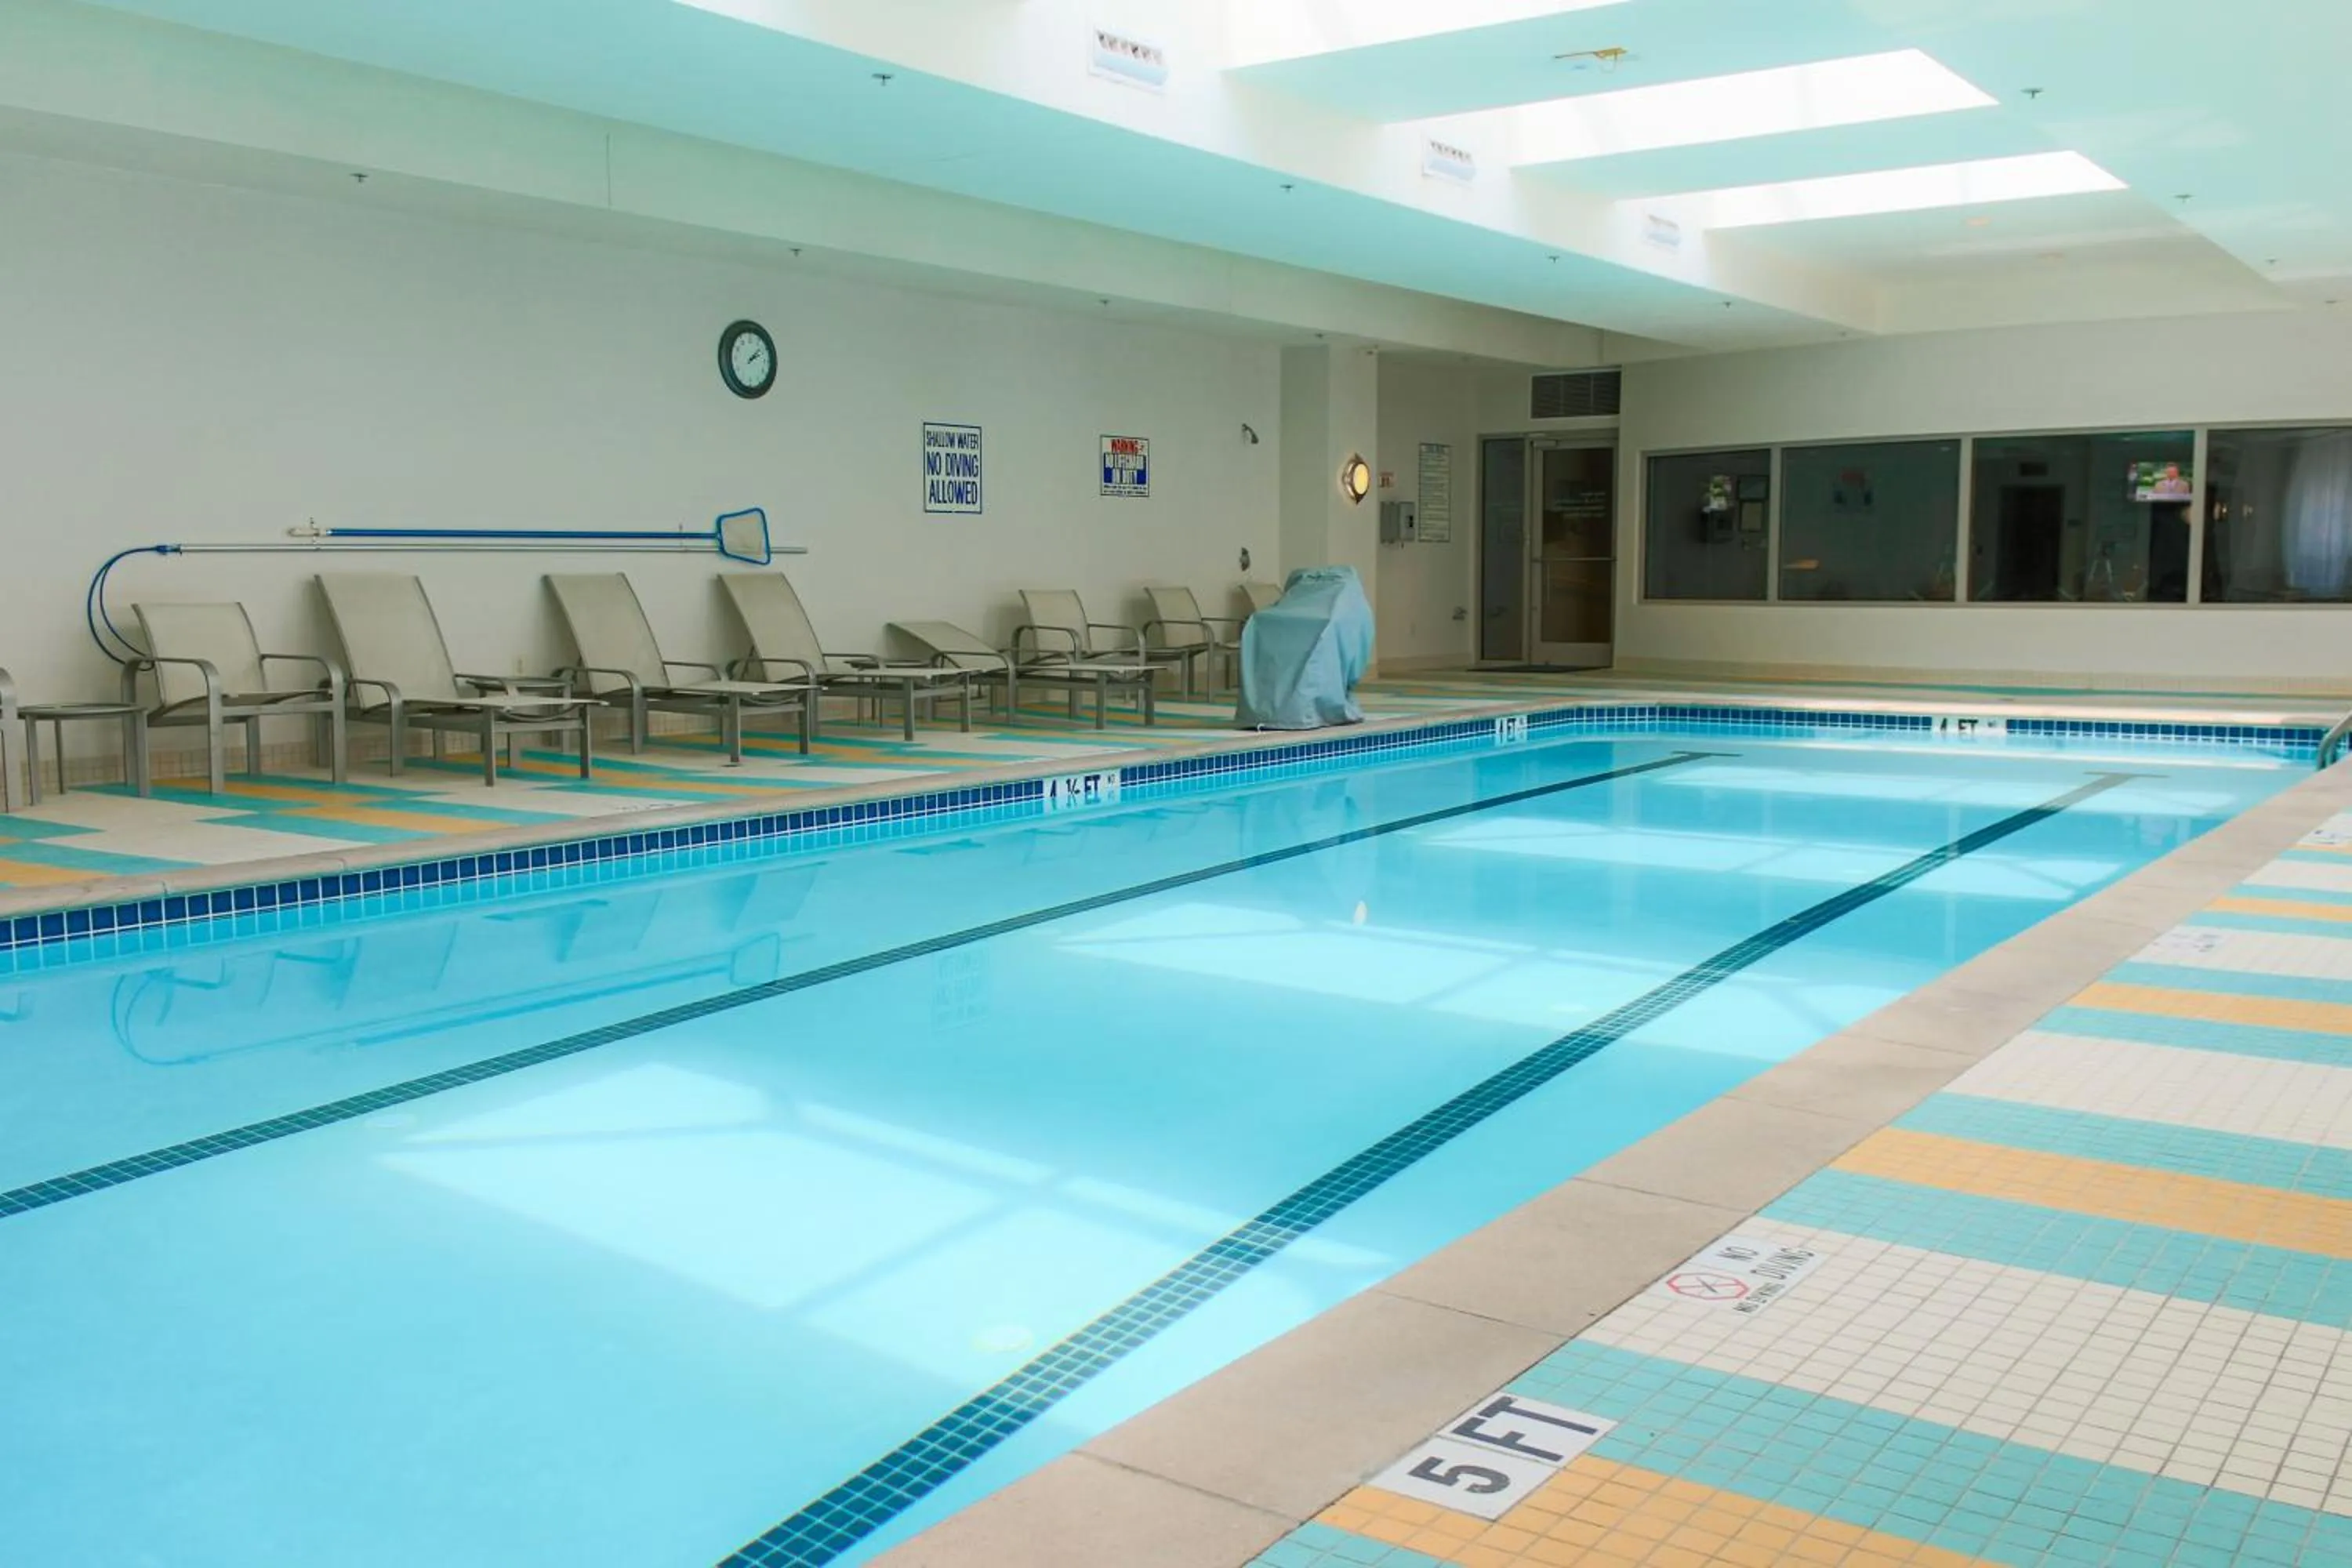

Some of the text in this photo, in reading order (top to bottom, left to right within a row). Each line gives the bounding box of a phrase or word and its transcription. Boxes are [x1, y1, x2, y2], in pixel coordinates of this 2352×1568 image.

[927, 430, 978, 449] SHALLOW WATER
[927, 452, 979, 477] NO DIVING
[929, 479, 978, 504] ALLOWED
[1083, 774, 1101, 793] FT
[1716, 1246, 1759, 1262] NO
[1750, 1247, 1815, 1279] DIVING
[1407, 1396, 1598, 1494] 5 FT
